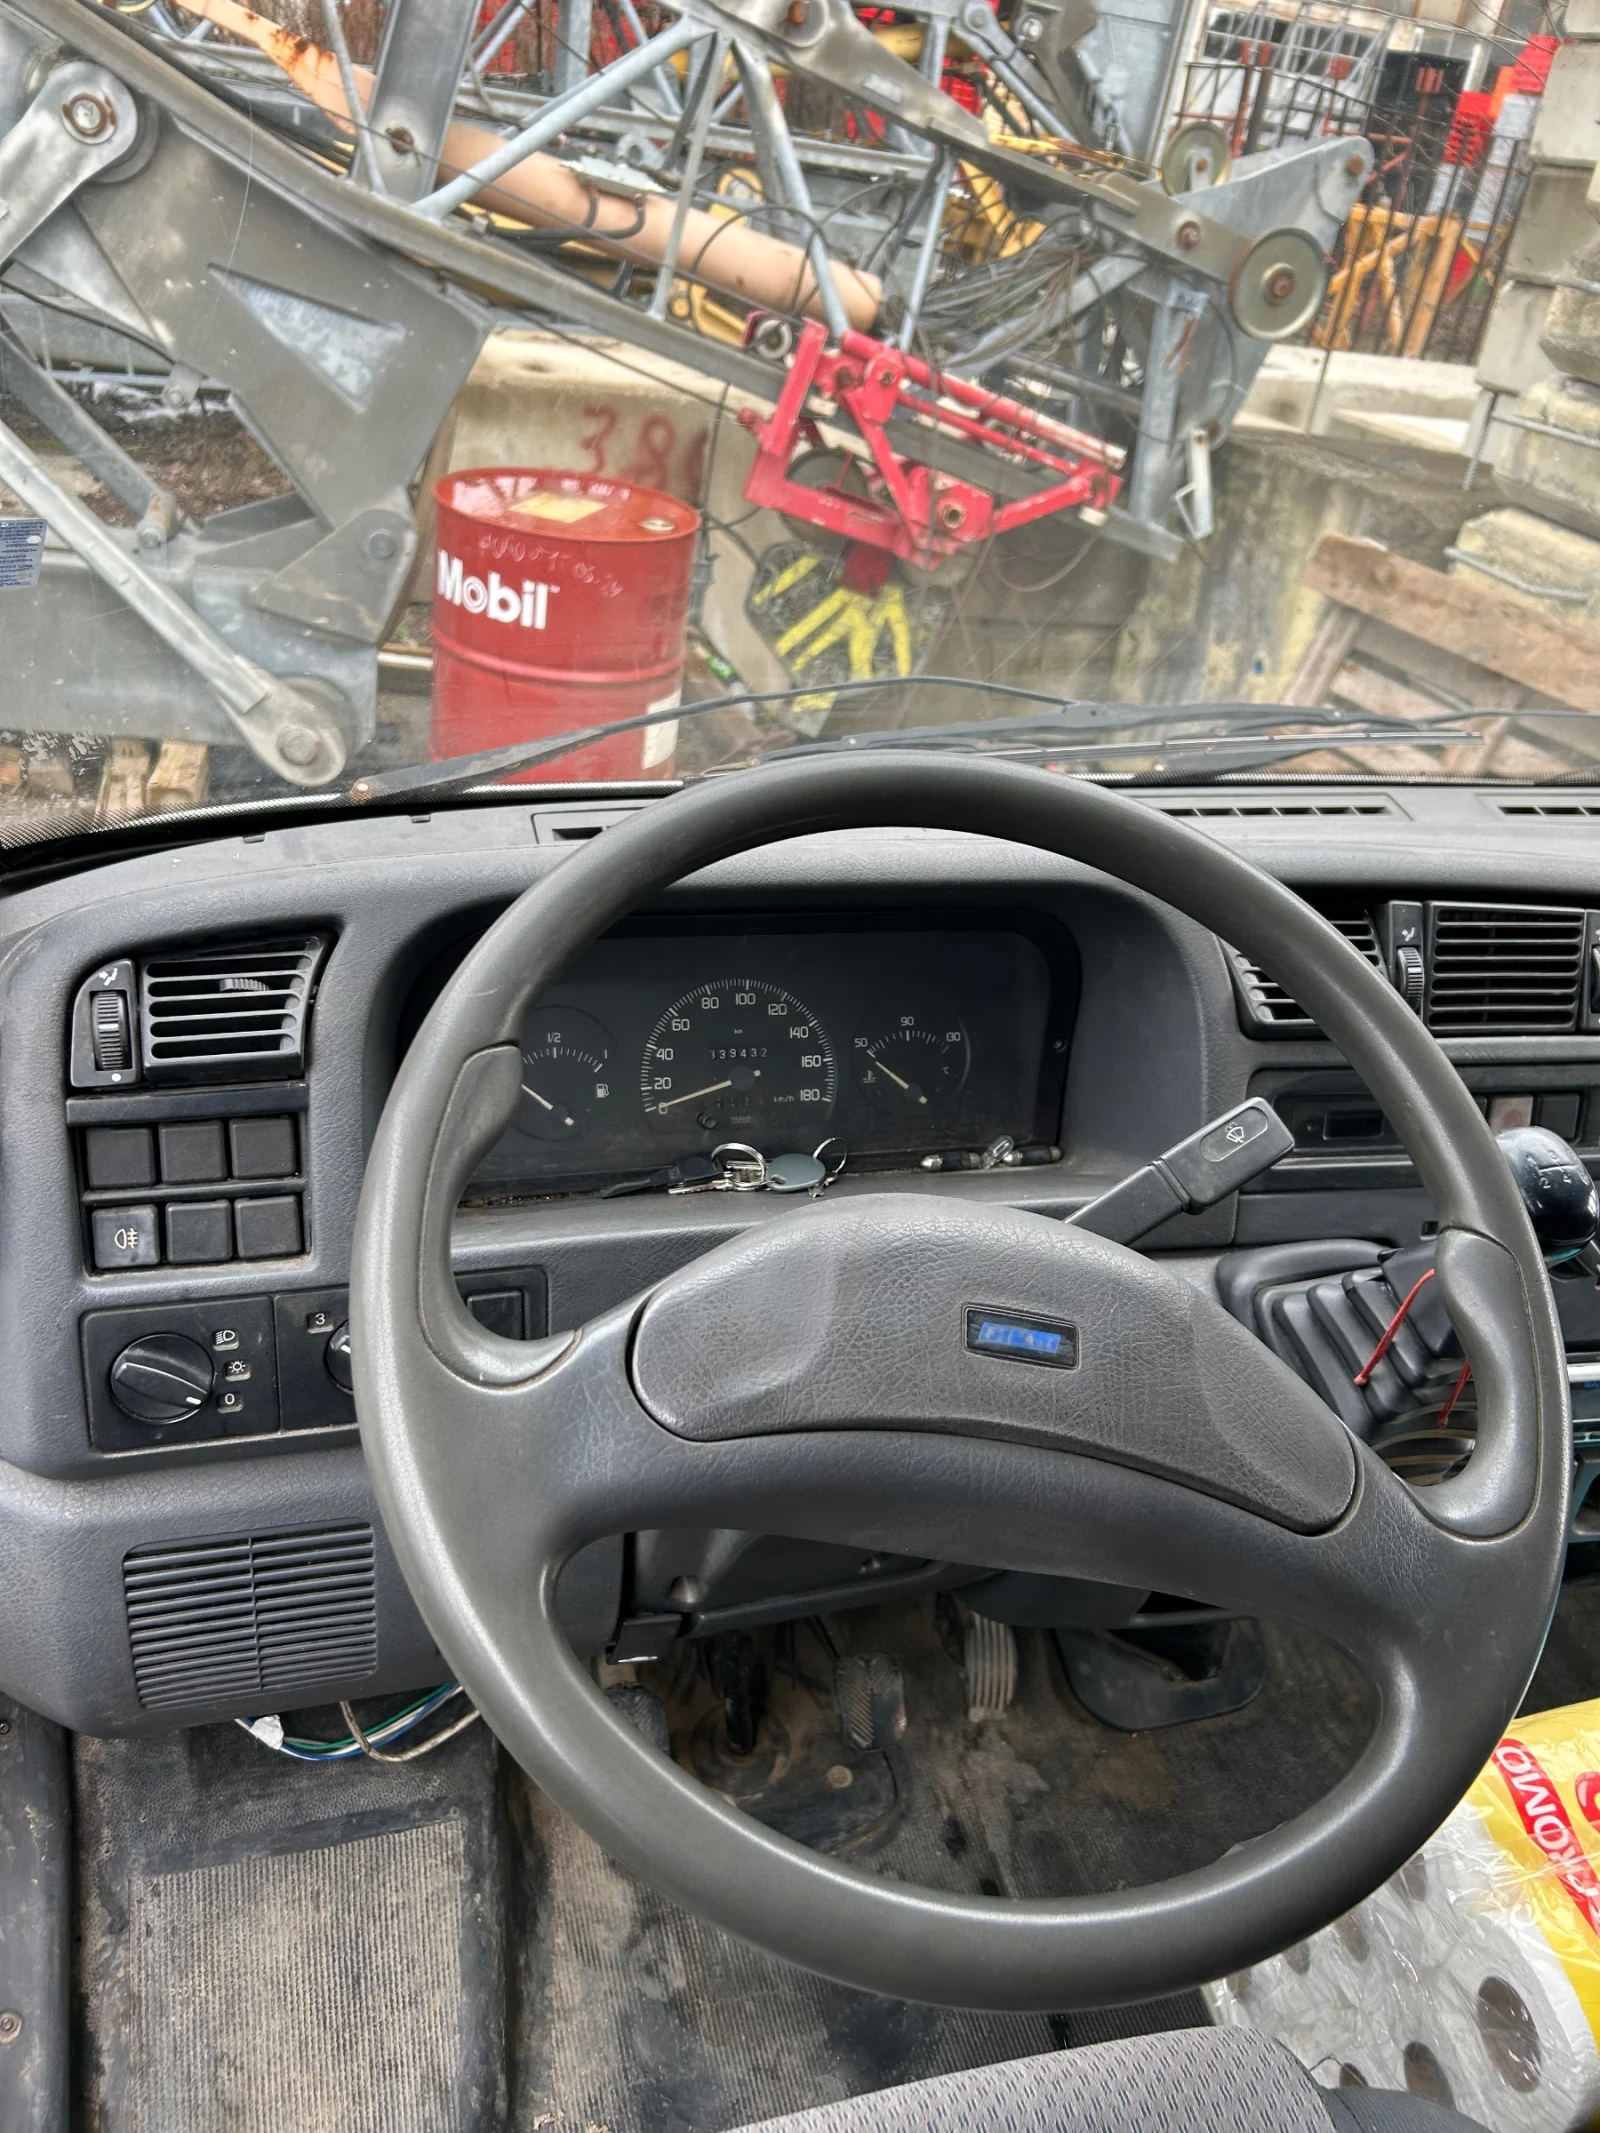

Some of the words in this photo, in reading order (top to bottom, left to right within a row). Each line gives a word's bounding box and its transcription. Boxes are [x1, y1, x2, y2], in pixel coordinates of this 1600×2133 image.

[438, 548, 549, 630] Mobil
[701, 997, 720, 1009] 80
[735, 993, 756, 1005] 100
[768, 1004, 787, 1016] 120
[672, 1019, 690, 1031] 60
[900, 1016, 914, 1026] 90
[547, 1032, 561, 1043] 1/2
[789, 1026, 809, 1038] 140
[946, 1032, 961, 1042] 130
[854, 1038, 868, 1048] 50
[656, 1048, 674, 1060] 40
[801, 1055, 821, 1067] 160
[654, 1077, 672, 1090] 20
[800, 1089, 820, 1101] 180
[658, 1102, 668, 1115] 0
[315, 1313, 326, 1326] 3
[224, 1393, 235, 1405] 0
